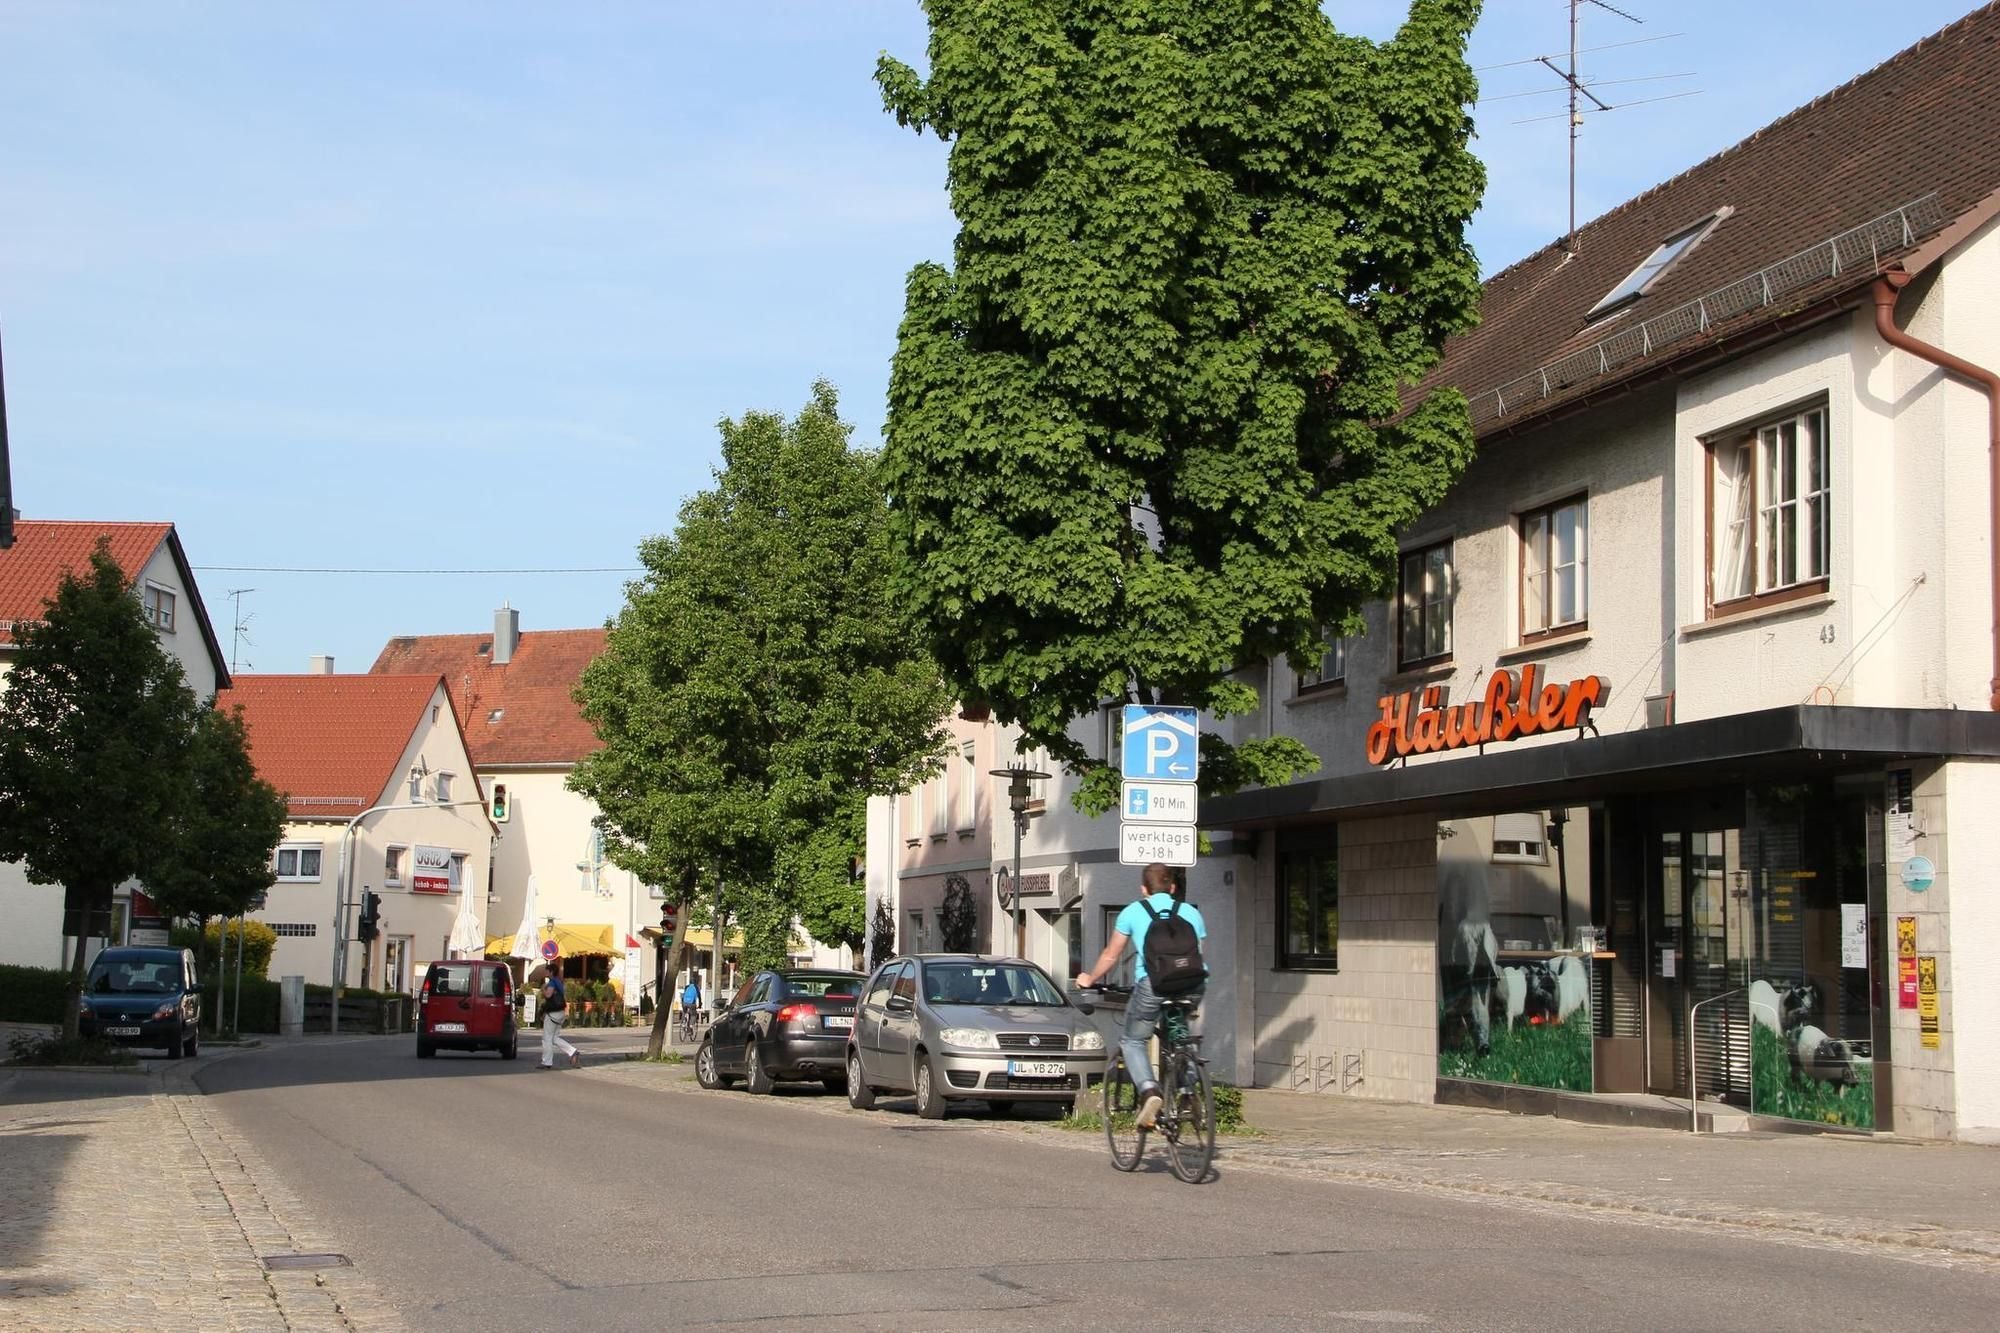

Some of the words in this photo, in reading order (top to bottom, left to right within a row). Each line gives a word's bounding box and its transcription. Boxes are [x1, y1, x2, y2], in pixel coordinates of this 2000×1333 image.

[1820, 624, 1835, 644] 43
[1366, 664, 1604, 765] Häußler
[1147, 730, 1178, 774] P
[1153, 797, 1165, 809] 90
[1127, 831, 1190, 846] werktags
[1014, 1063, 1027, 1073] UL
[1033, 1063, 1046, 1074] YB
[1047, 1063, 1065, 1074] 276
